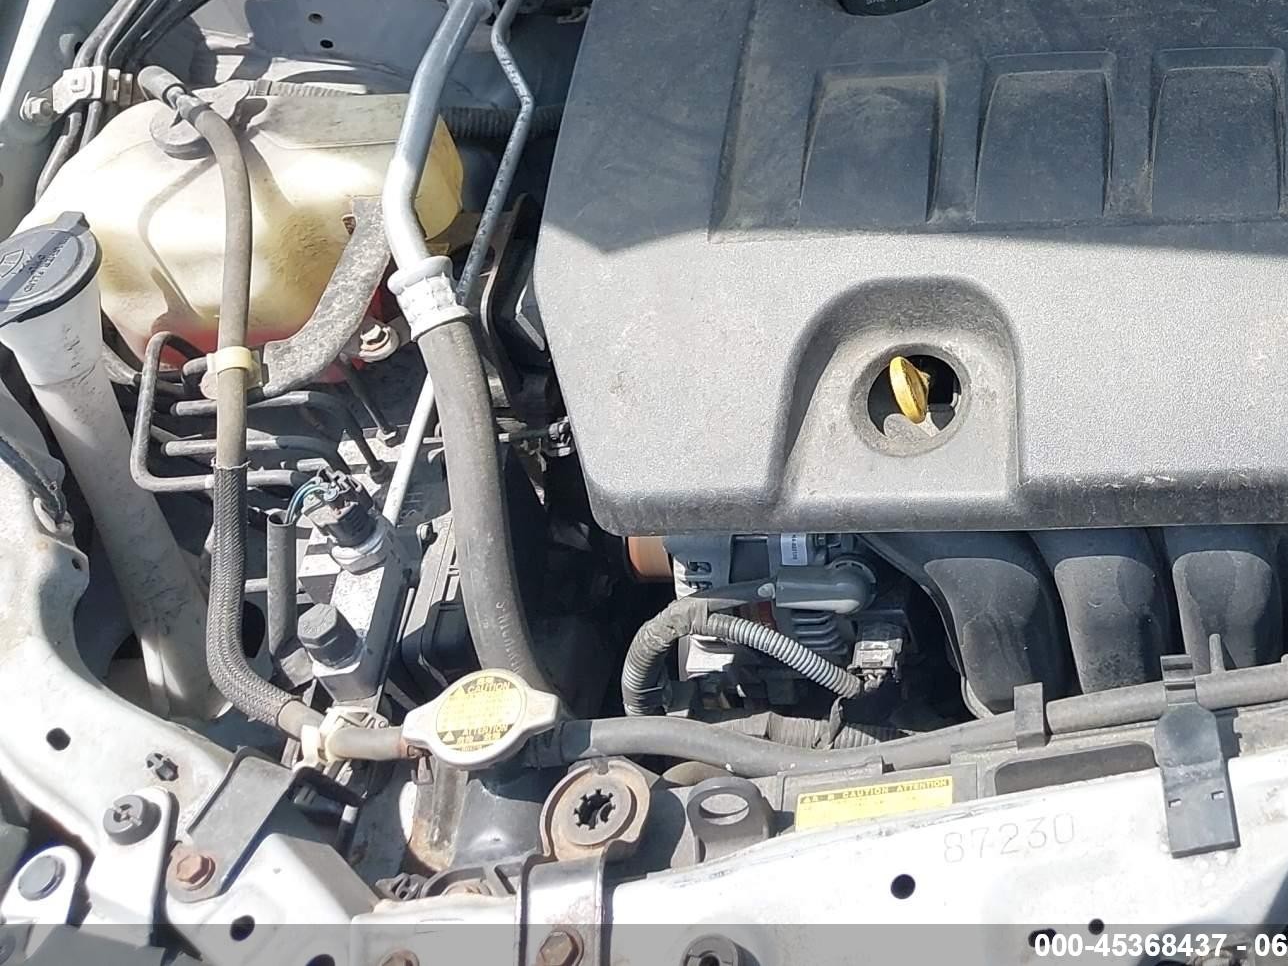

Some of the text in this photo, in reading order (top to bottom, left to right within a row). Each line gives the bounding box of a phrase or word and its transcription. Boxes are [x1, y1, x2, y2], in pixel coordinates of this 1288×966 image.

[842, 786, 889, 799] CAUTION
[895, 779, 948, 792] ATTENTION
[943, 812, 1075, 864] 87230
